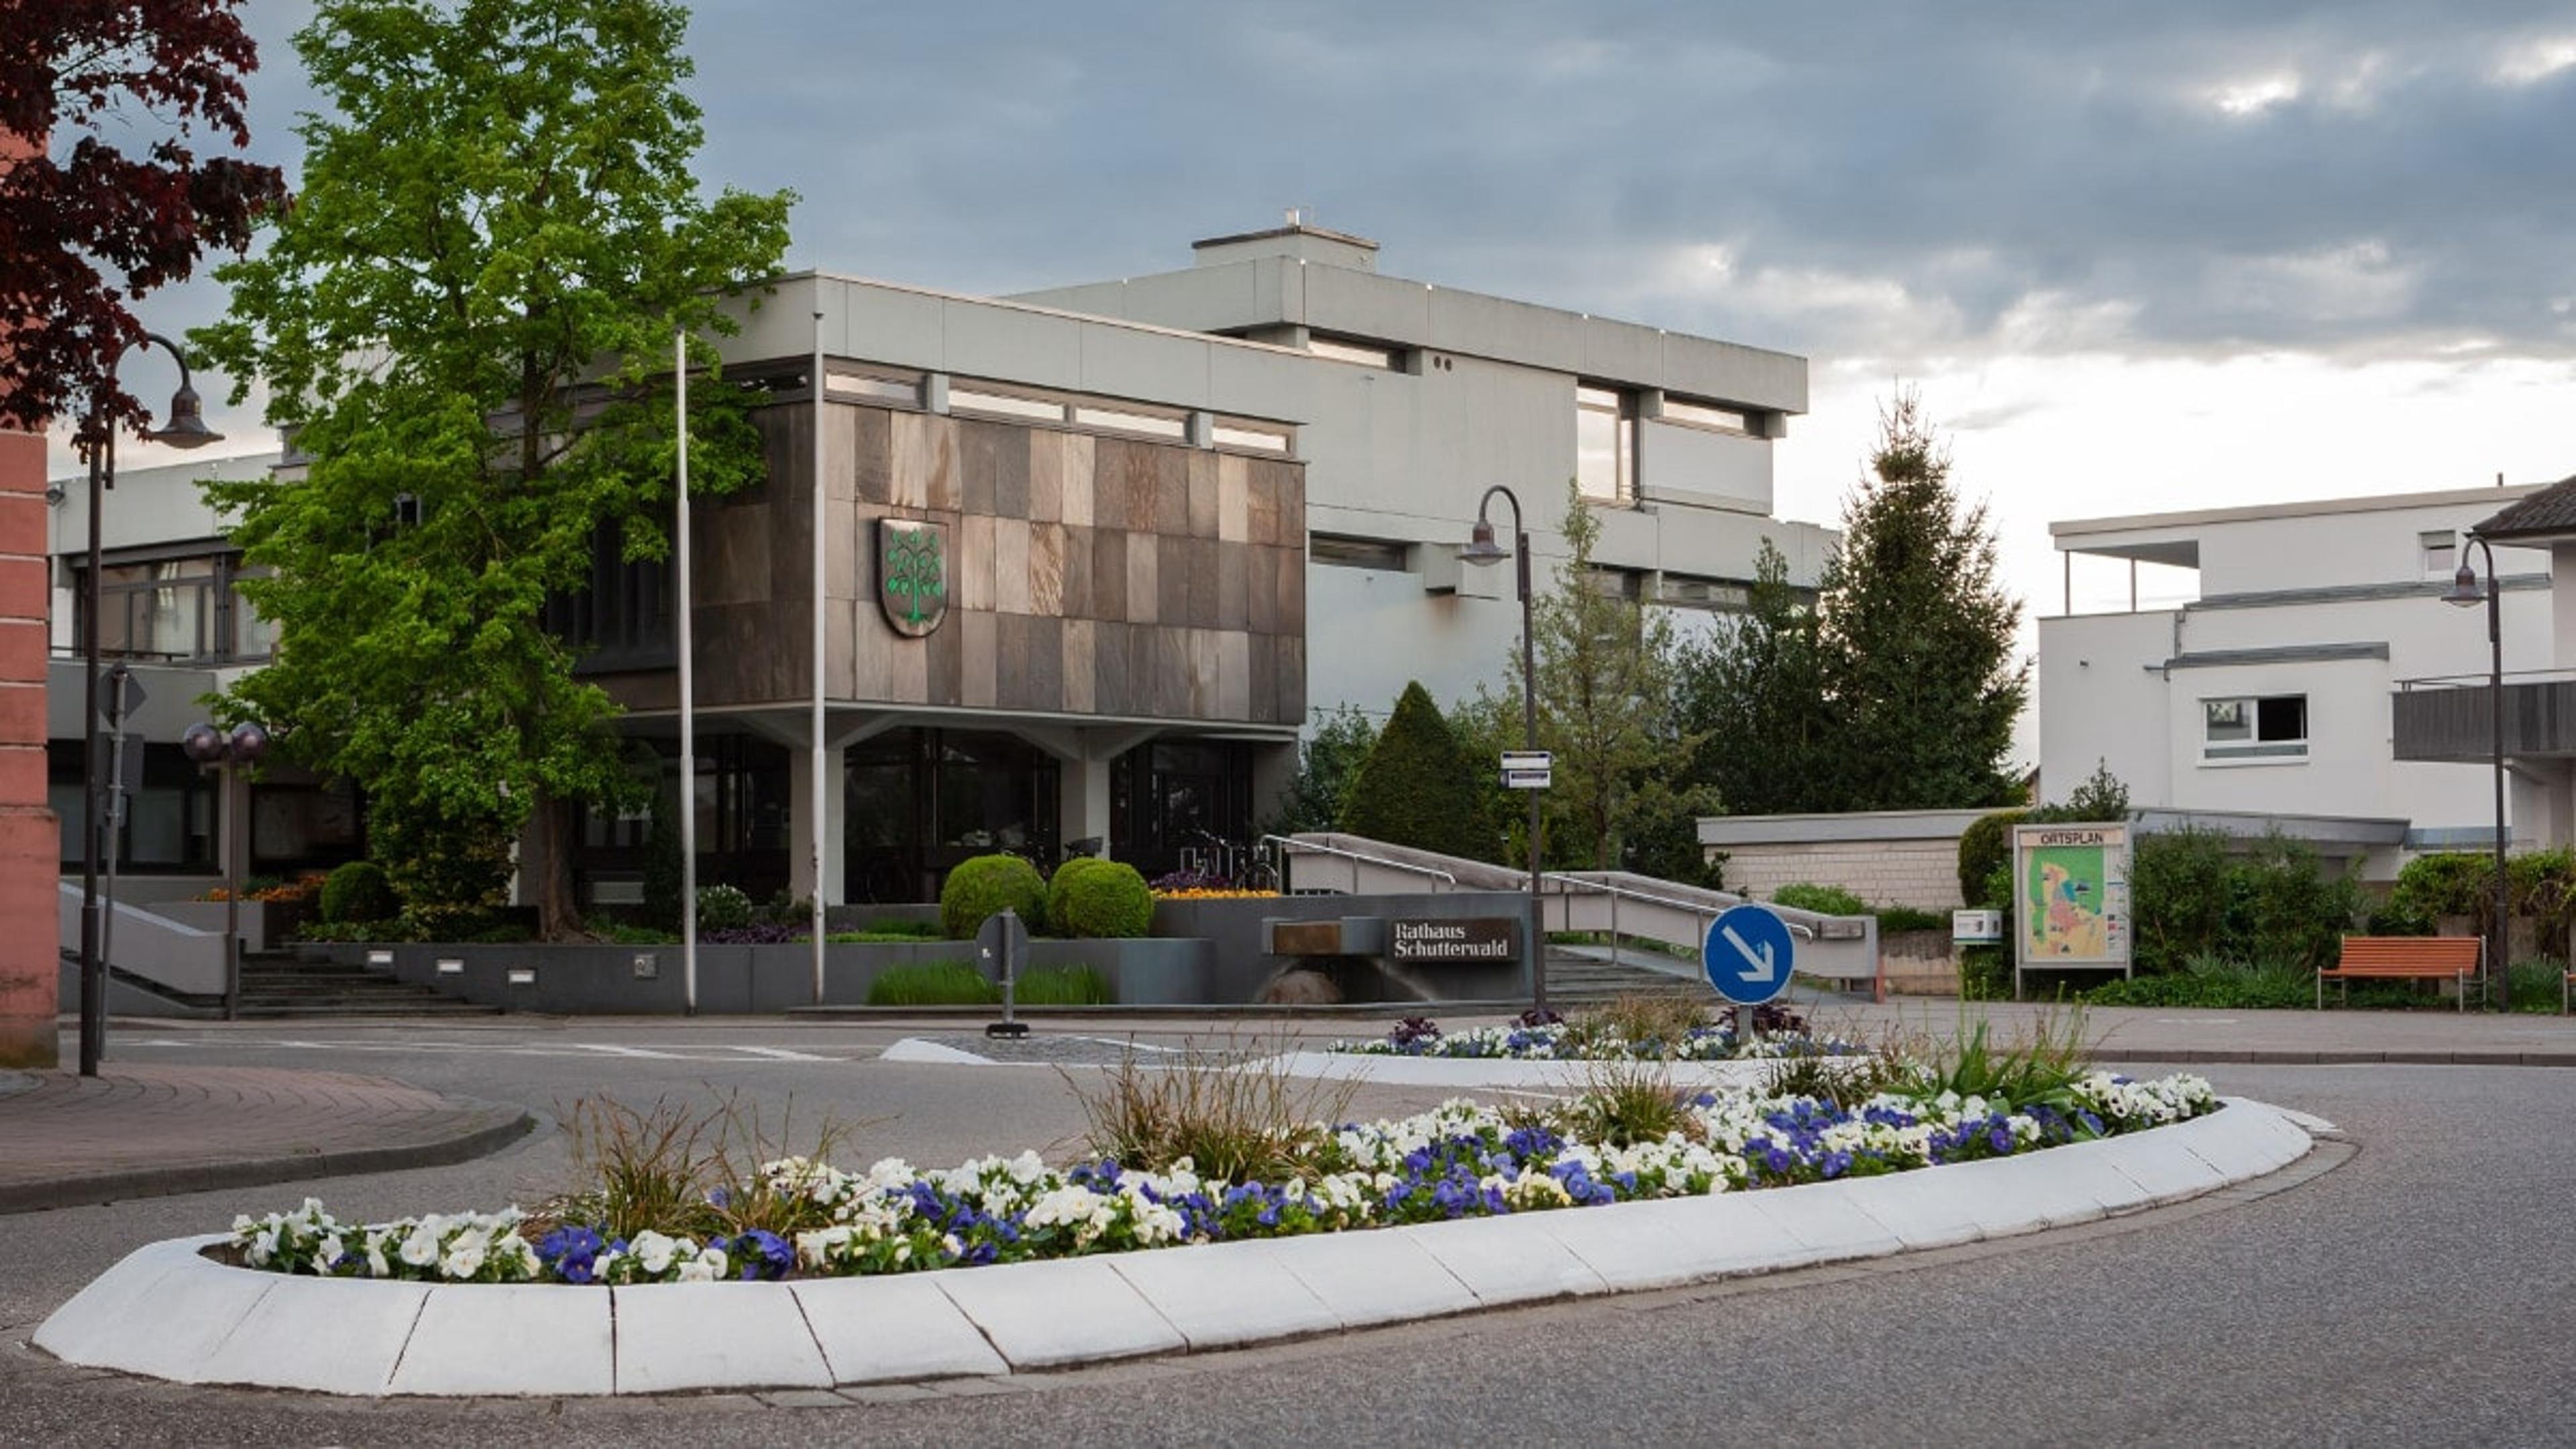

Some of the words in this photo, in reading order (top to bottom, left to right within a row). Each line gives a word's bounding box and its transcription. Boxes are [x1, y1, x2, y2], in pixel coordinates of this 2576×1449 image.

[2041, 832, 2104, 845] ORTSPLAN
[1395, 922, 1466, 939] Rathaus
[1394, 939, 1508, 958] Schutterwald
